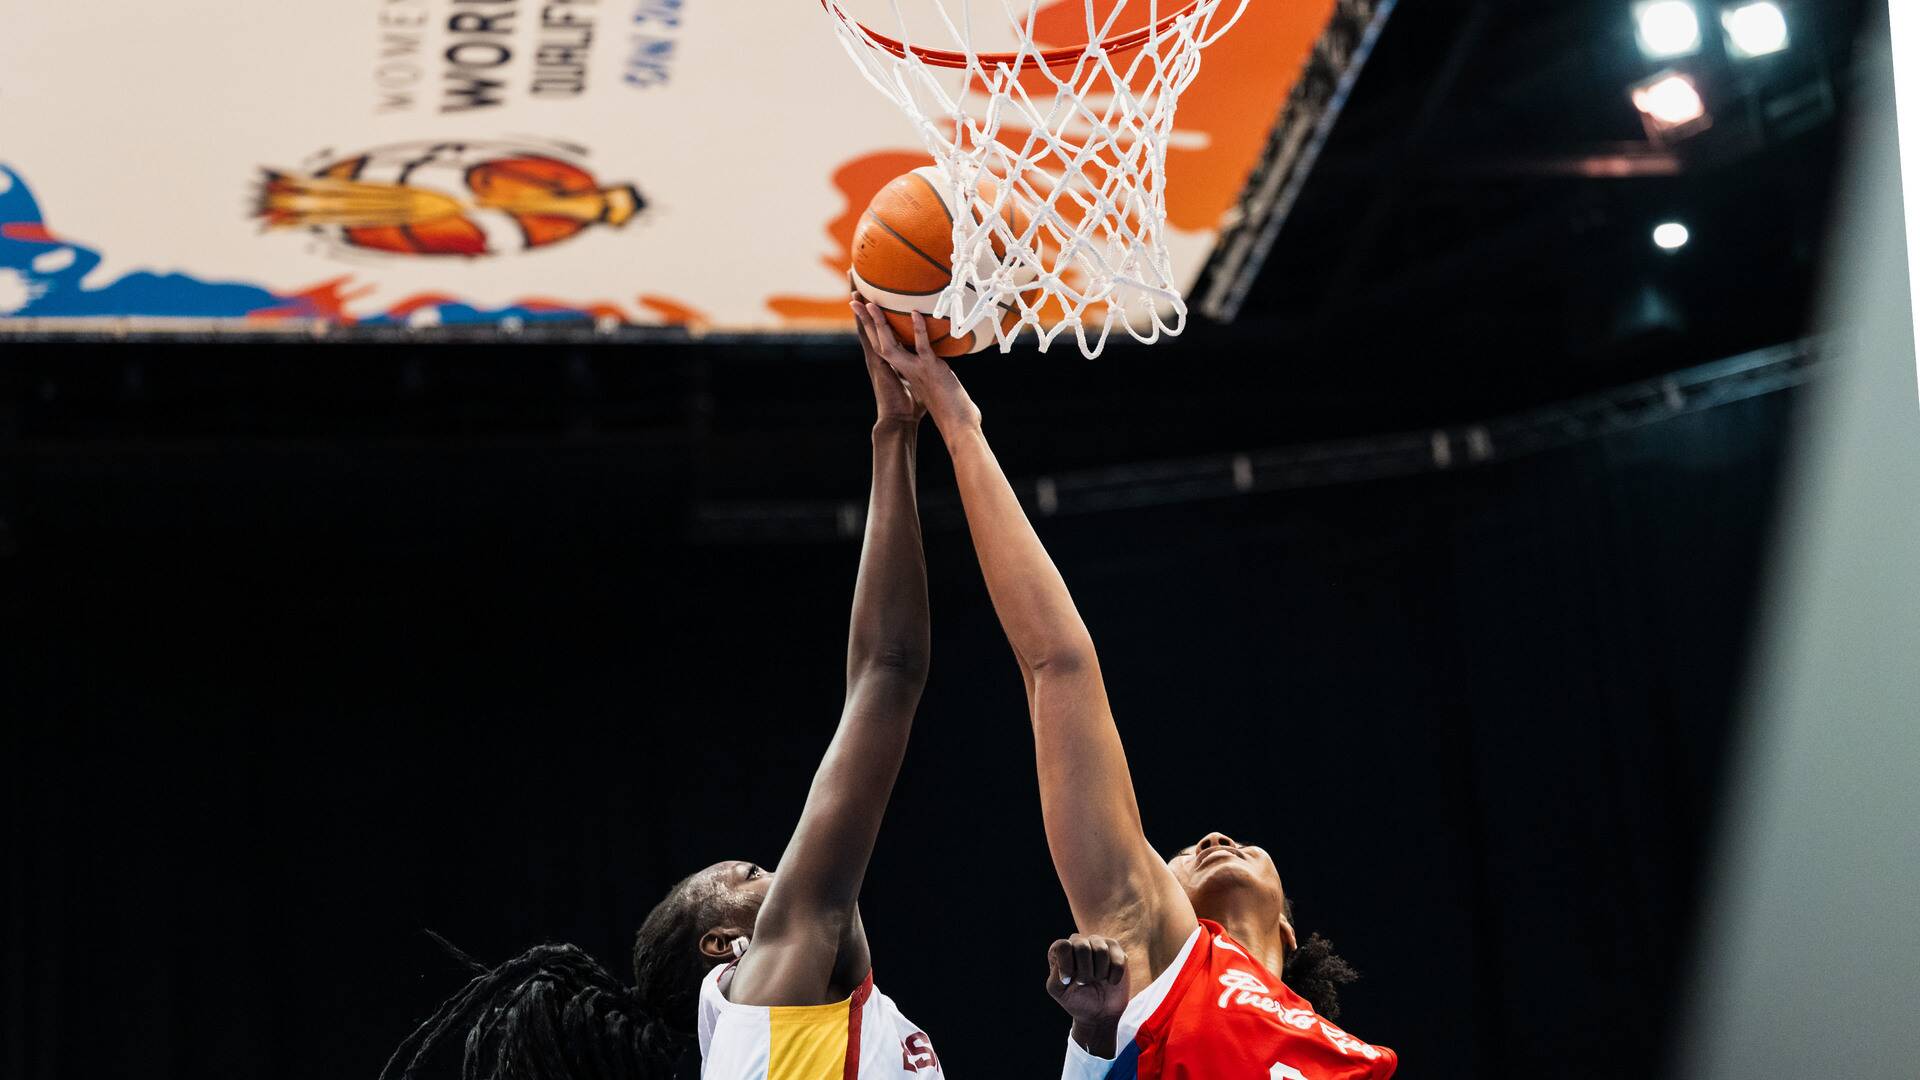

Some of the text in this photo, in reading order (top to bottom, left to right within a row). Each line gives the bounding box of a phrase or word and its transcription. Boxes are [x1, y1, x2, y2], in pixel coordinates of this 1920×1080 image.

[374, 0, 428, 115] WOME
[438, 0, 518, 114] WOR
[530, 0, 597, 97] QUALIF
[1217, 968, 1317, 1030] Puerto
